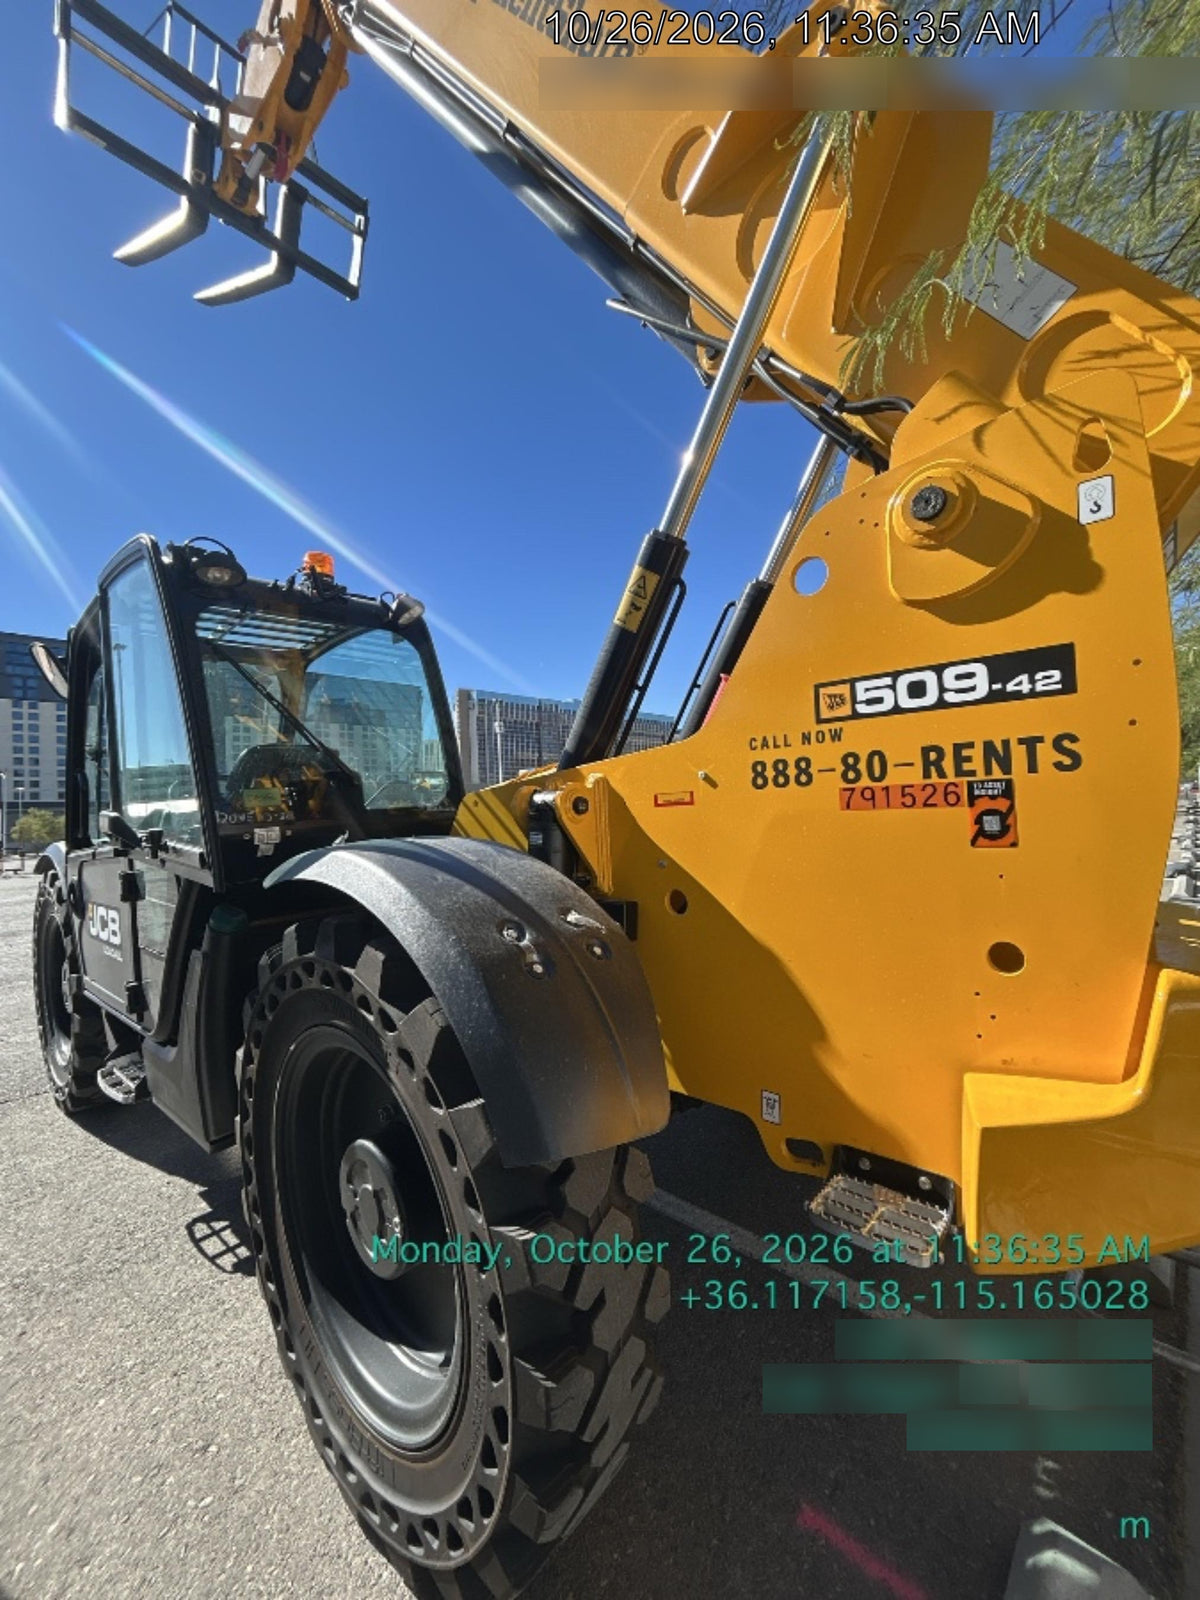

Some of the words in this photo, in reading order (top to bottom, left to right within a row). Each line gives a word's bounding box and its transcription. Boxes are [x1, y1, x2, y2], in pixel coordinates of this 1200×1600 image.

[854, 662, 1063, 714] 509-42
[749, 734, 792, 751] CALL
[801, 727, 843, 746] NOW
[751, 732, 1083, 790] 888-80-RENTS
[842, 781, 962, 809] 791526
[88, 903, 122, 946] JCB
